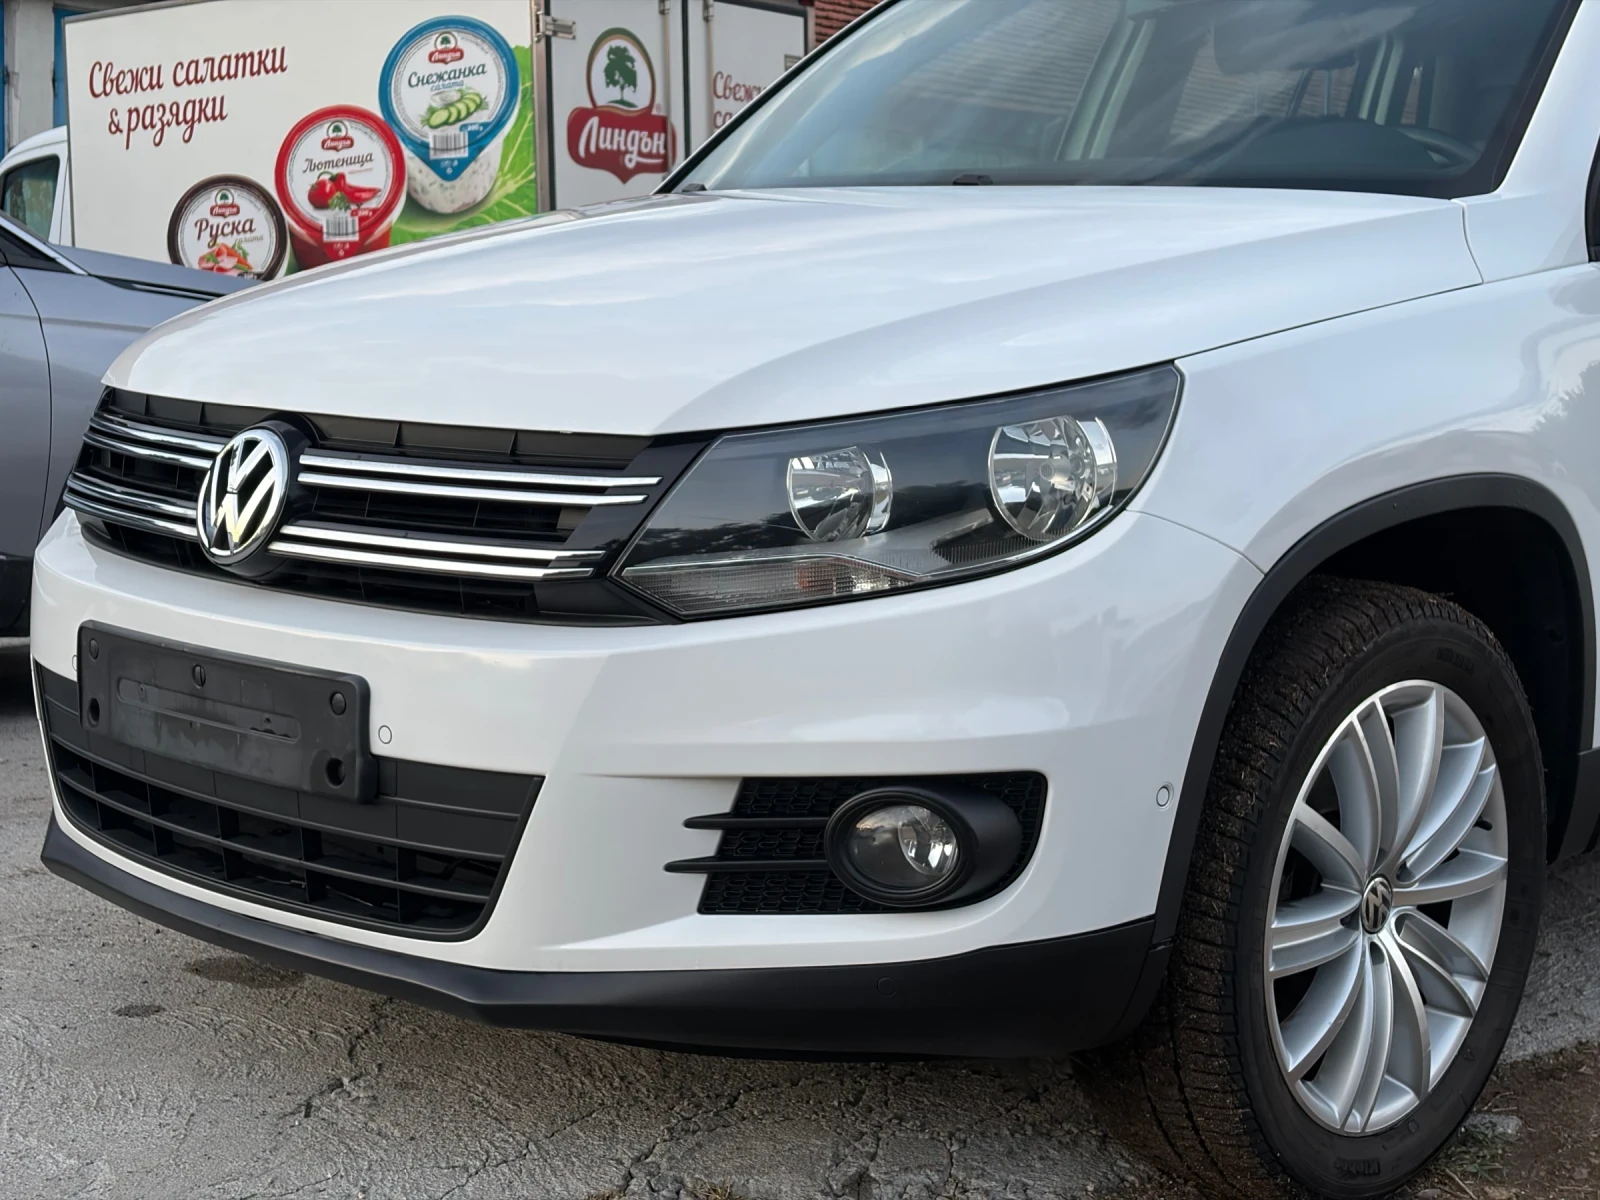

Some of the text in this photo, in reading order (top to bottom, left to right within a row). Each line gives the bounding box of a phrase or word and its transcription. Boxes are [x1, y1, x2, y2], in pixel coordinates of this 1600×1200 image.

[89, 46, 288, 98] Свежи салатки
[407, 63, 487, 88] Снежанка
[713, 70, 768, 103] Свеж
[108, 95, 228, 150] & разядки
[578, 115, 665, 169] Линдън
[302, 152, 375, 174] Лютеница
[194, 217, 257, 249] Руска
